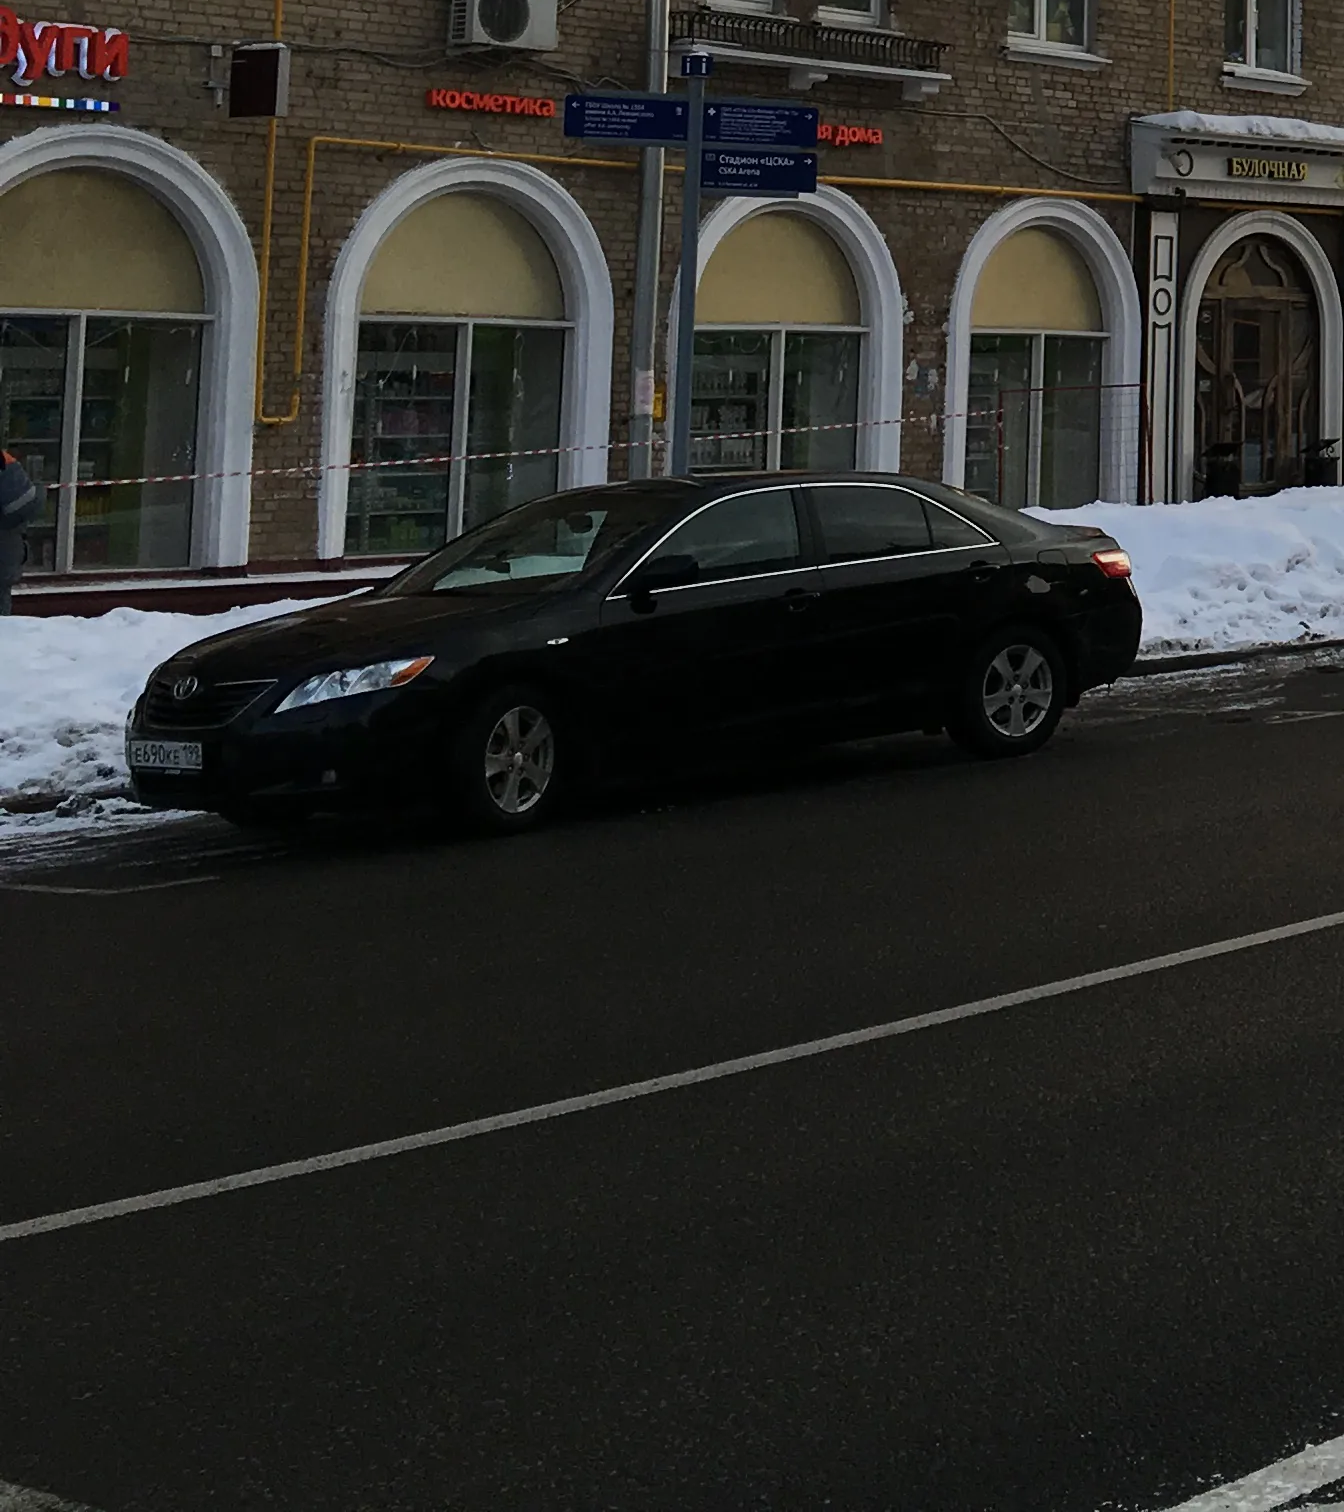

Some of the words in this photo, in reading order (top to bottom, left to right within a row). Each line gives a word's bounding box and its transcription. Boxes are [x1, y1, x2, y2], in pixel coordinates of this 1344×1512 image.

[428, 88, 556, 117] косметика
[835, 124, 883, 146] дома
[718, 166, 737, 175] CSKA
[738, 168, 761, 176] Arena
[719, 154, 759, 165] Стадион
[760, 156, 795, 166] «ЦСКА»
[1230, 158, 1308, 180] БУЛОЧНАЯ
